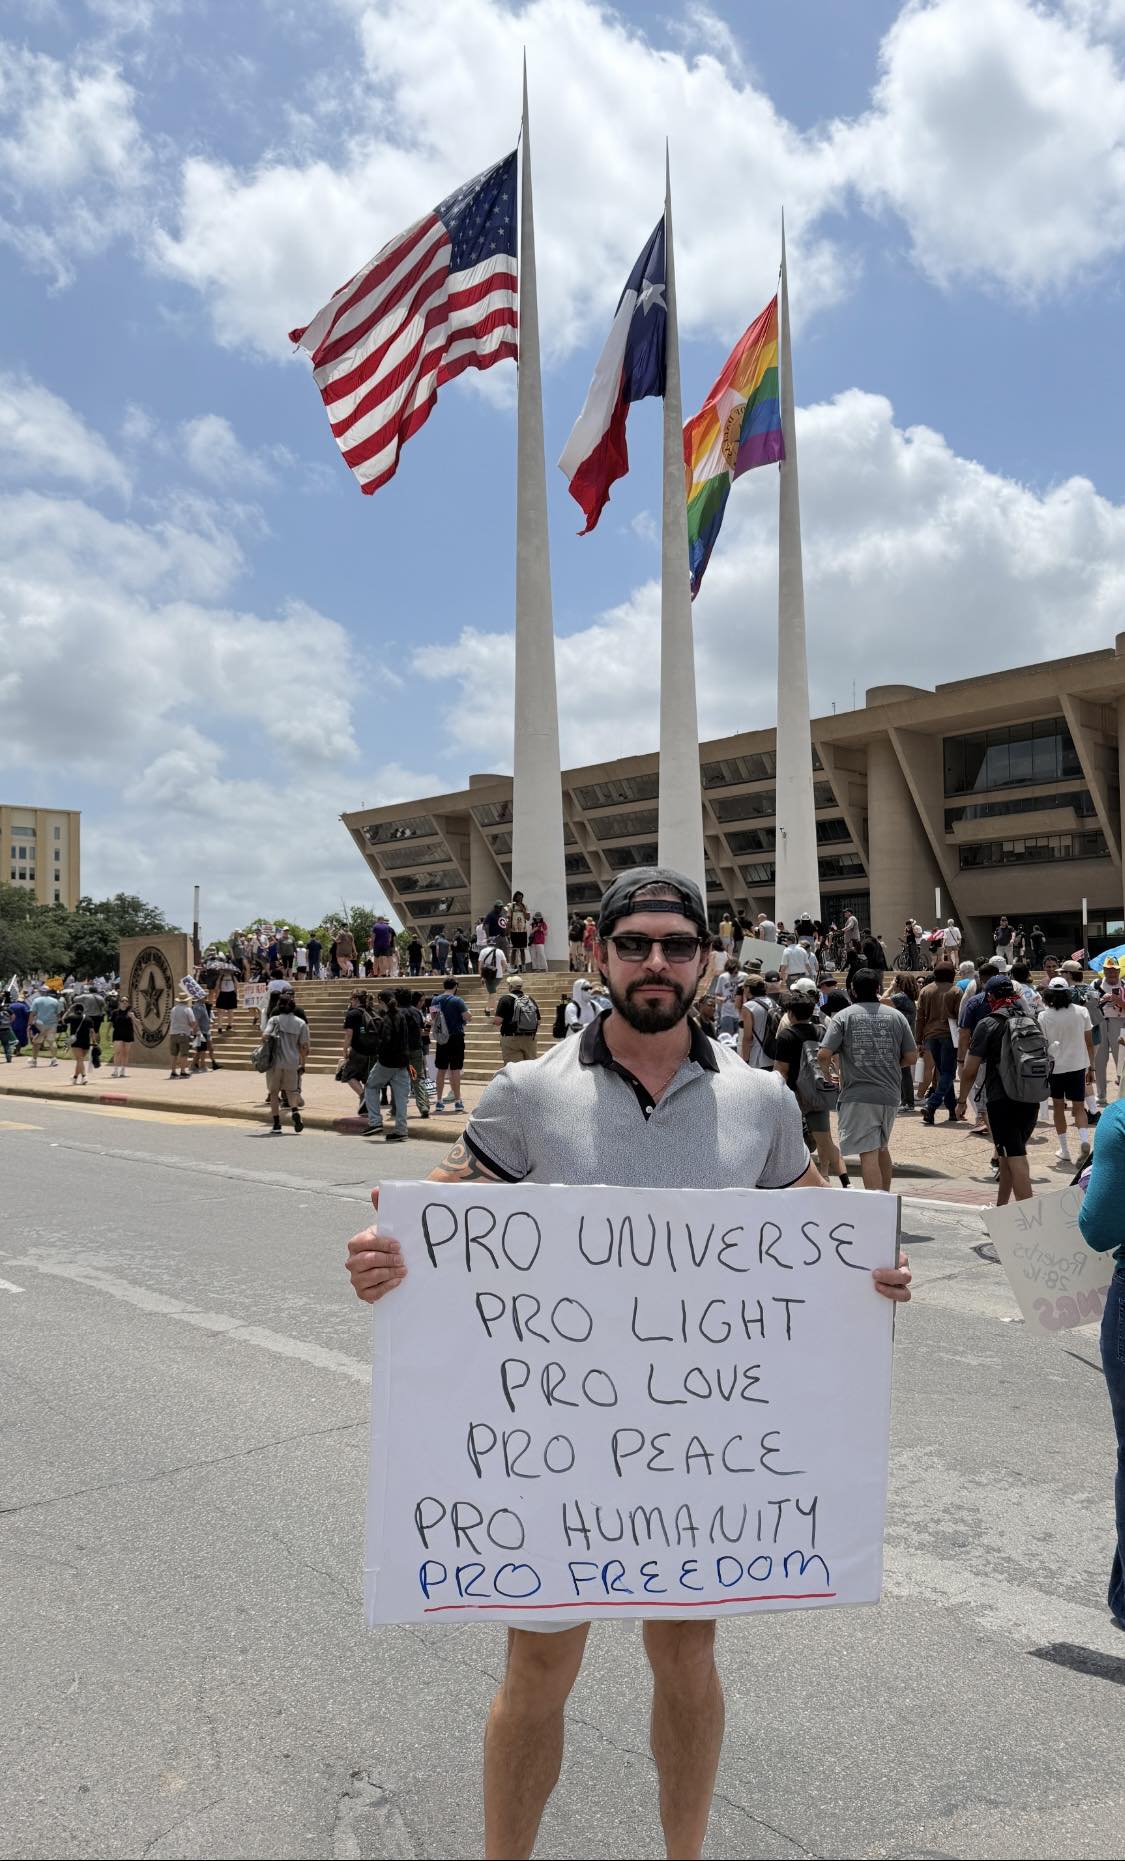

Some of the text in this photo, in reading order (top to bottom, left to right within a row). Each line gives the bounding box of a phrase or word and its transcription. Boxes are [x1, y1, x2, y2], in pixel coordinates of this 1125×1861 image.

[422, 1202, 872, 1274] PRO UNIVERSE
[476, 1292, 806, 1344] PRO LIGHT
[500, 1358, 770, 1413] PRO LOVE
[467, 1422, 807, 1480] PRO PEACE
[414, 1495, 819, 1556] PRO HUMANITY
[419, 1550, 830, 1600] PRO FREEDOM
